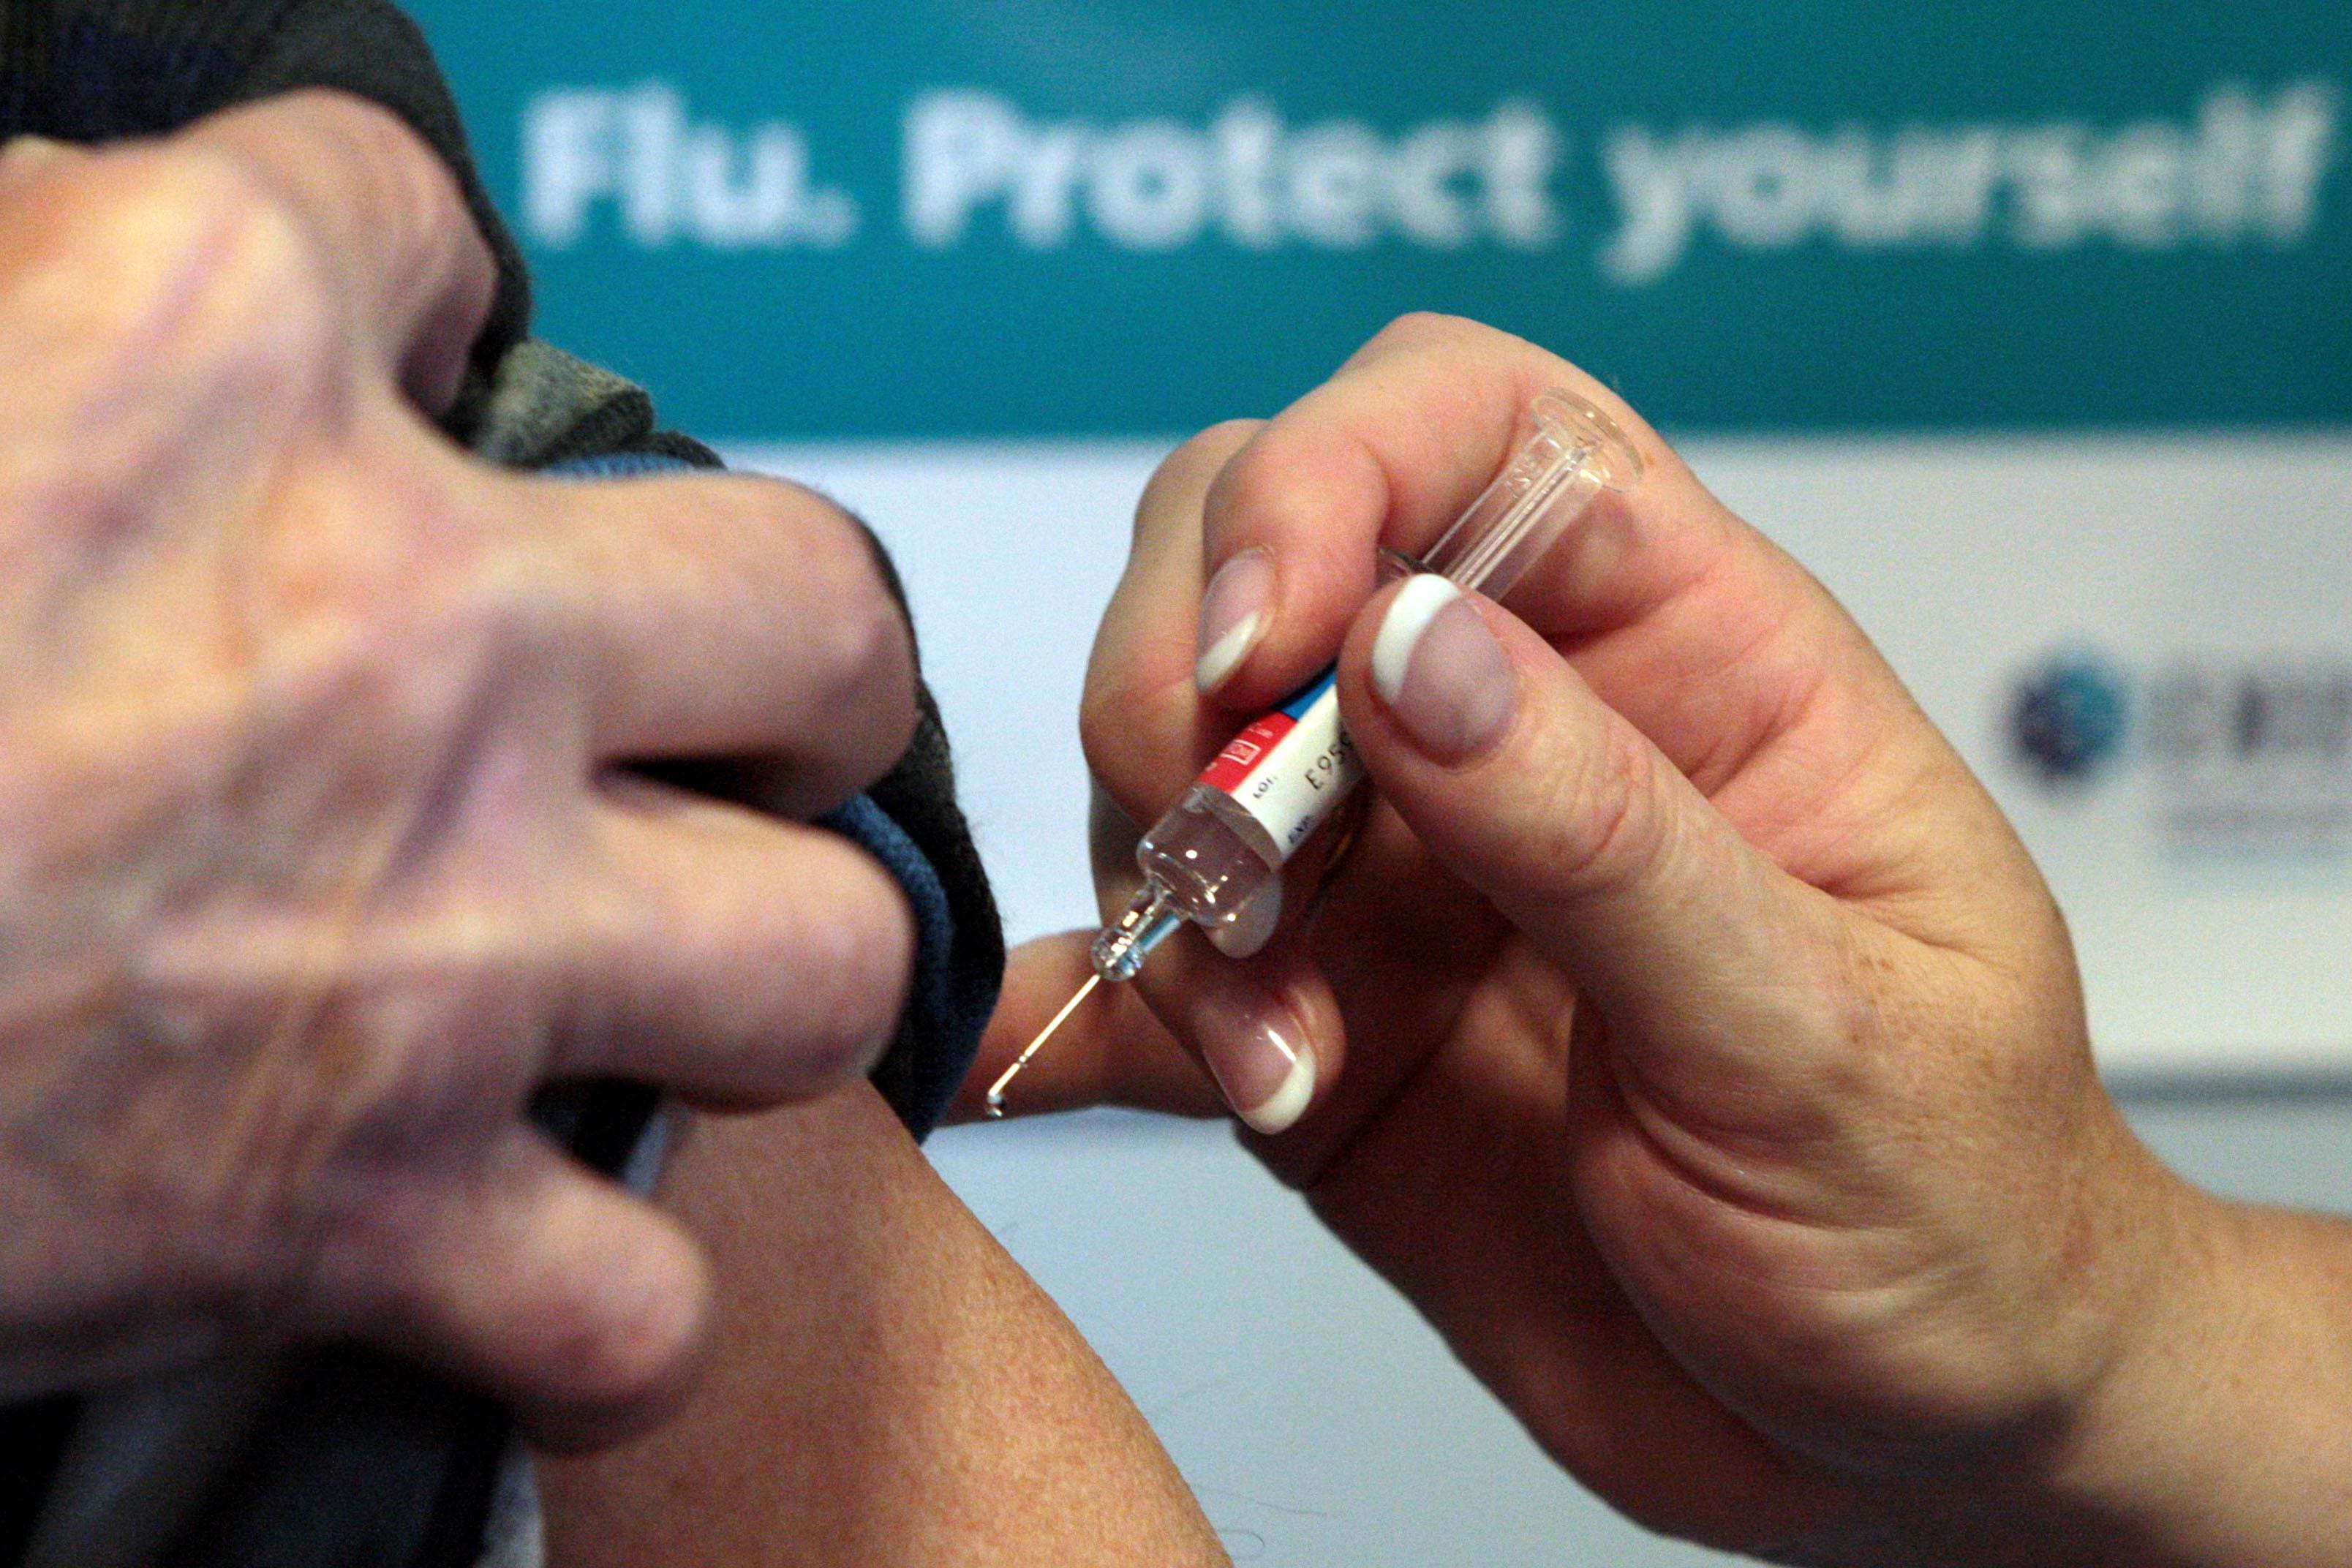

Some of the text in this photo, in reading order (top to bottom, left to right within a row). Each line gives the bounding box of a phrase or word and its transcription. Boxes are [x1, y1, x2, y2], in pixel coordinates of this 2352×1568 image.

[521, 83, 2333, 282] Flu. Protect yourself
